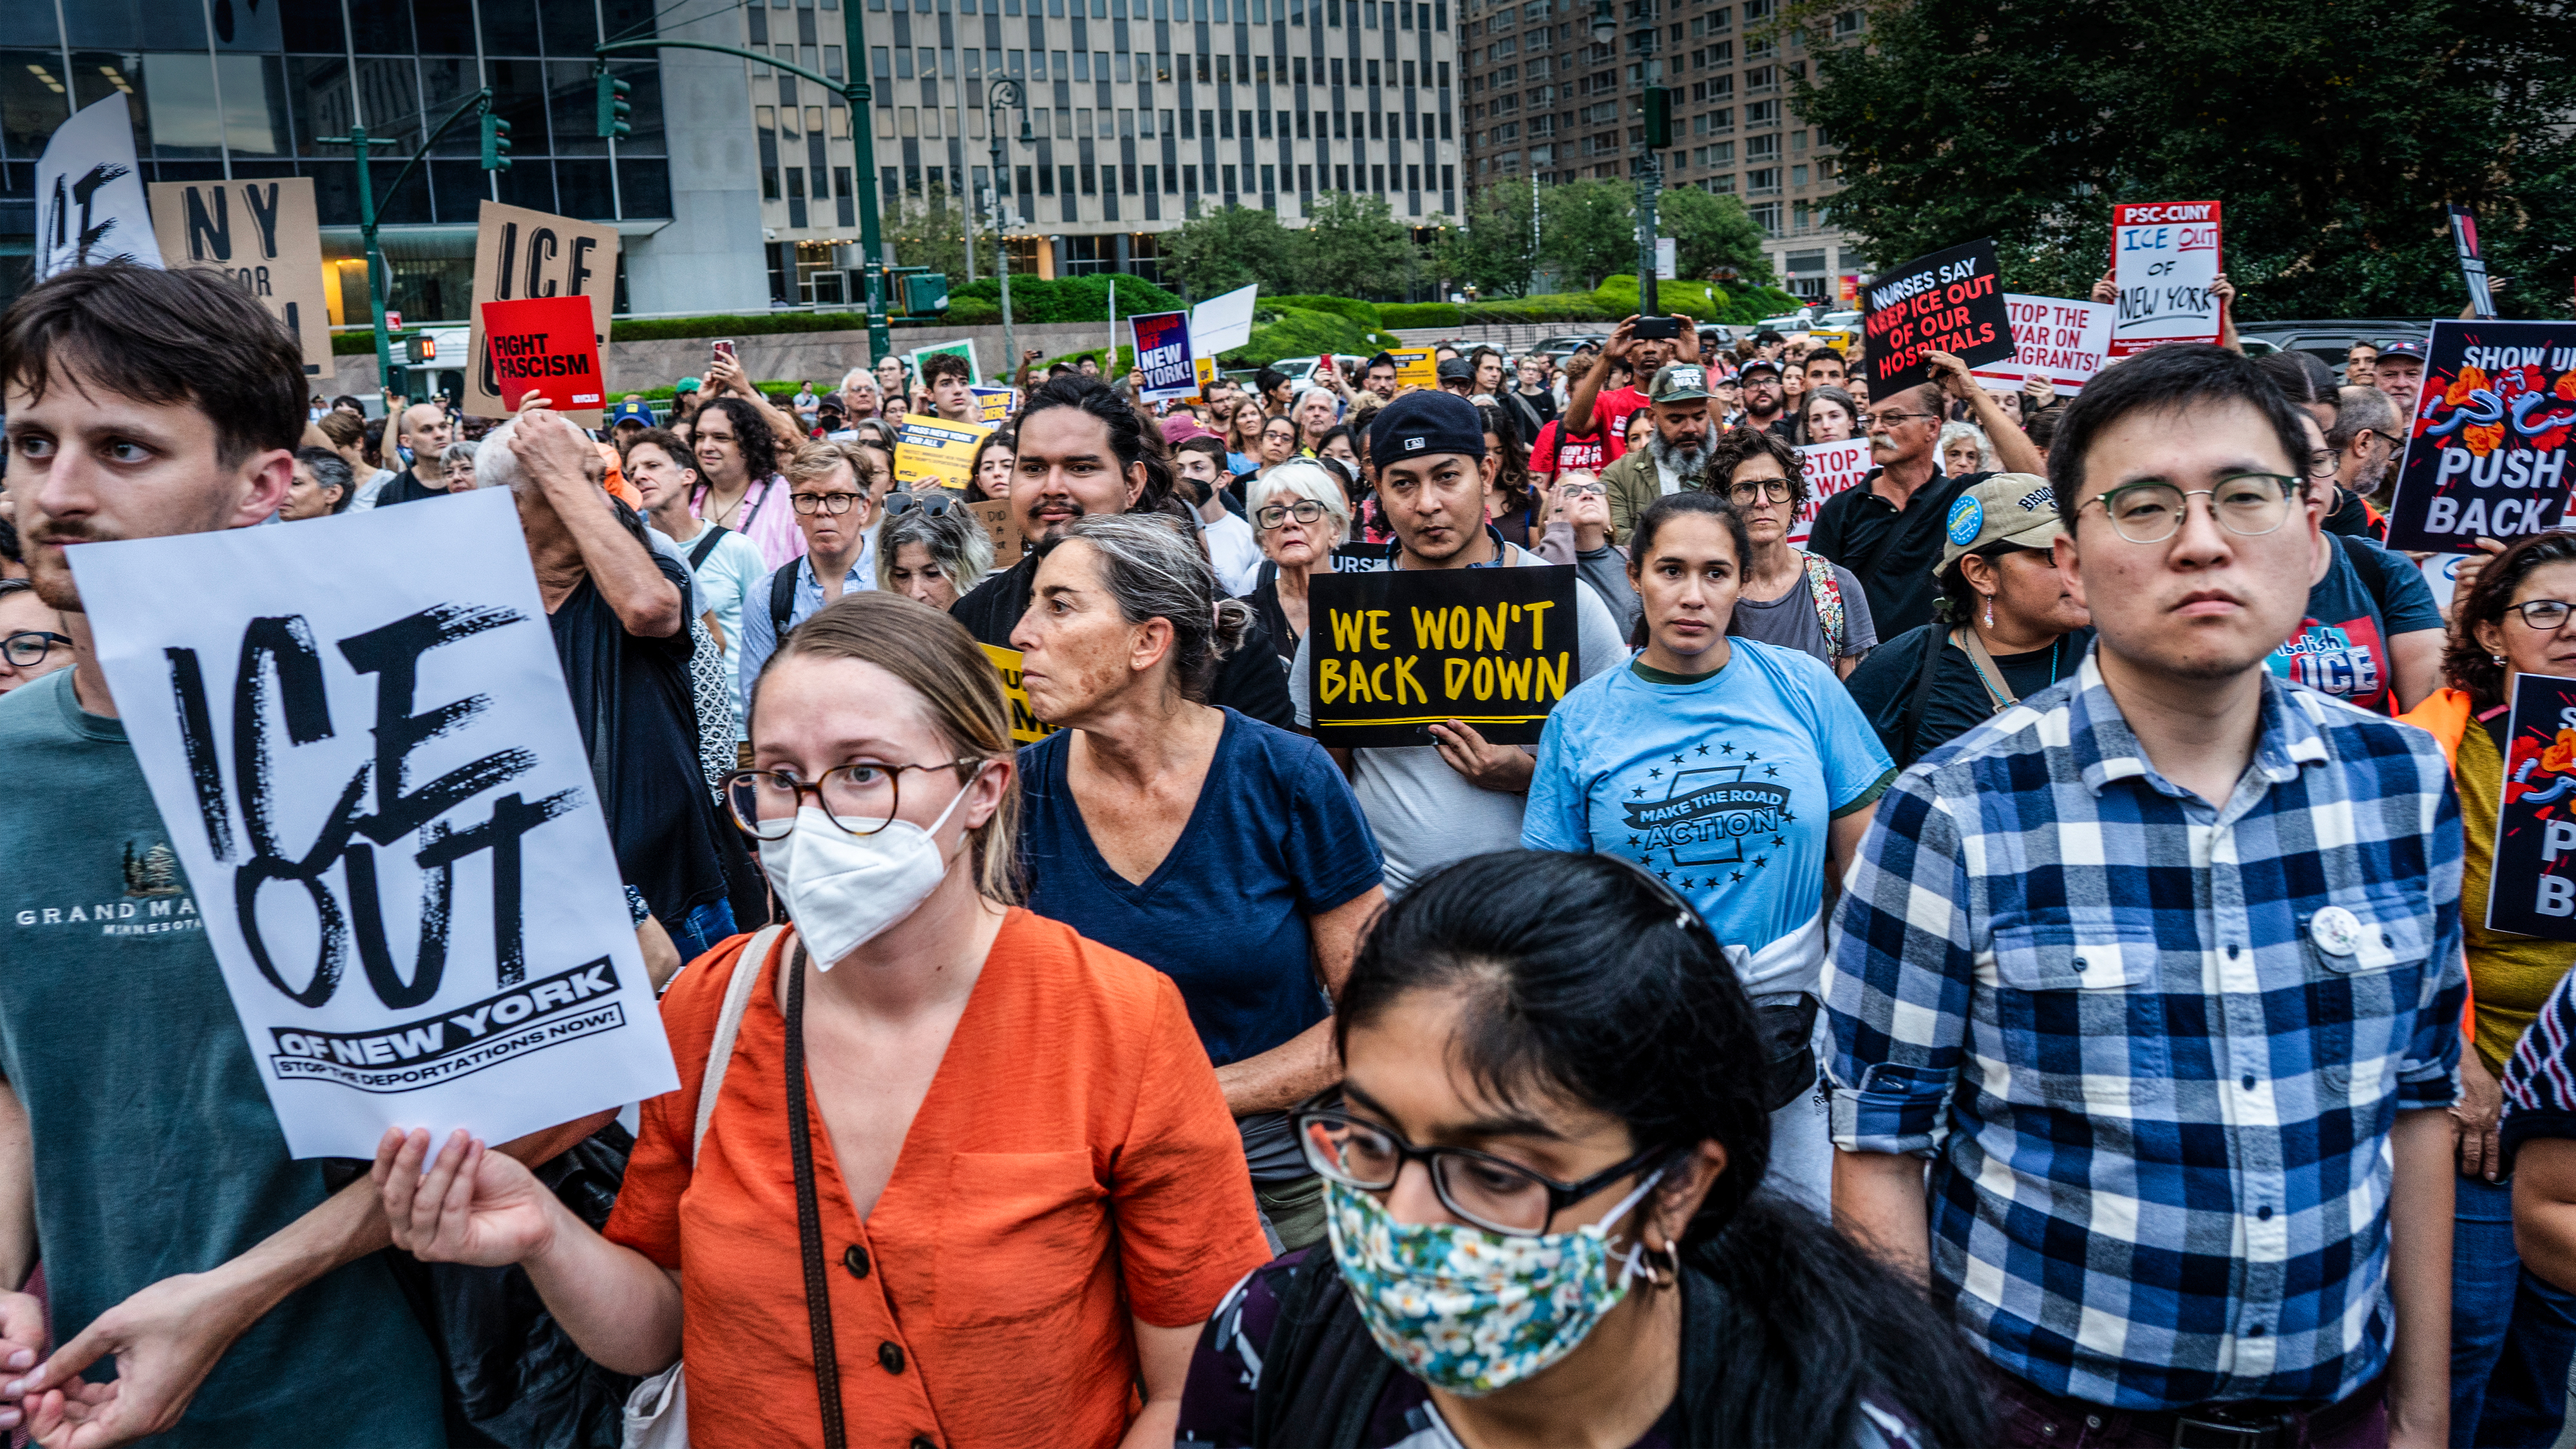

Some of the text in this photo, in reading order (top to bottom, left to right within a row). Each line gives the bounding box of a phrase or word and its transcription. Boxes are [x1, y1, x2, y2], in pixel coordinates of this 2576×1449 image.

[182, 182, 279, 261] NY
[2125, 205, 2211, 223] PSC-CUNY
[2124, 227, 2217, 251] ICE OUT
[2147, 261, 2176, 276] OF
[1871, 257, 1976, 312] NURSES SAY
[1866, 273, 1995, 339] KEEP ICE OUT
[2005, 303, 2090, 328] TOP THE
[2119, 285, 2212, 319] NEW YORK
[1136, 314, 1179, 336] HANDS
[1889, 306, 1972, 349] OF OUR
[2055, 328, 2081, 348] ON
[494, 333, 549, 357] FIGHT
[1139, 332, 1160, 351] OFF
[1879, 323, 1996, 380] HOSPITALS
[498, 354, 590, 378] FASCISM
[1141, 343, 1181, 372] NEW
[1998, 346, 2101, 373] IGRANTS!
[2461, 346, 2546, 370] SHOW
[1143, 361, 1191, 388] YORK!
[1672, 377, 1702, 386] WAX
[904, 436, 939, 447] FOR ALL
[907, 425, 972, 442] PASS NEW YORK
[1804, 448, 1859, 475] STOP
[2435, 446, 2567, 488] PUSH
[2017, 486, 2055, 513] BROO
[2424, 495, 2553, 536] BACK
[1329, 554, 1388, 573] URS
[1330, 600, 1555, 652] WE WON'T
[1320, 652, 1569, 705] BACK DOWN
[2296, 645, 2380, 697] ICE
[163, 602, 537, 873] ICE
[1640, 790, 1783, 823] MAKE THE ROAD
[1644, 806, 1779, 851] ACTION
[15, 898, 196, 926] GRAND MA
[234, 793, 587, 1010] OUT
[102, 918, 204, 936] MINNESOTA
[279, 964, 615, 1065] OF NEW YORK
[279, 1010, 617, 1086] STOP THE DEPORTATIONS NOW!
